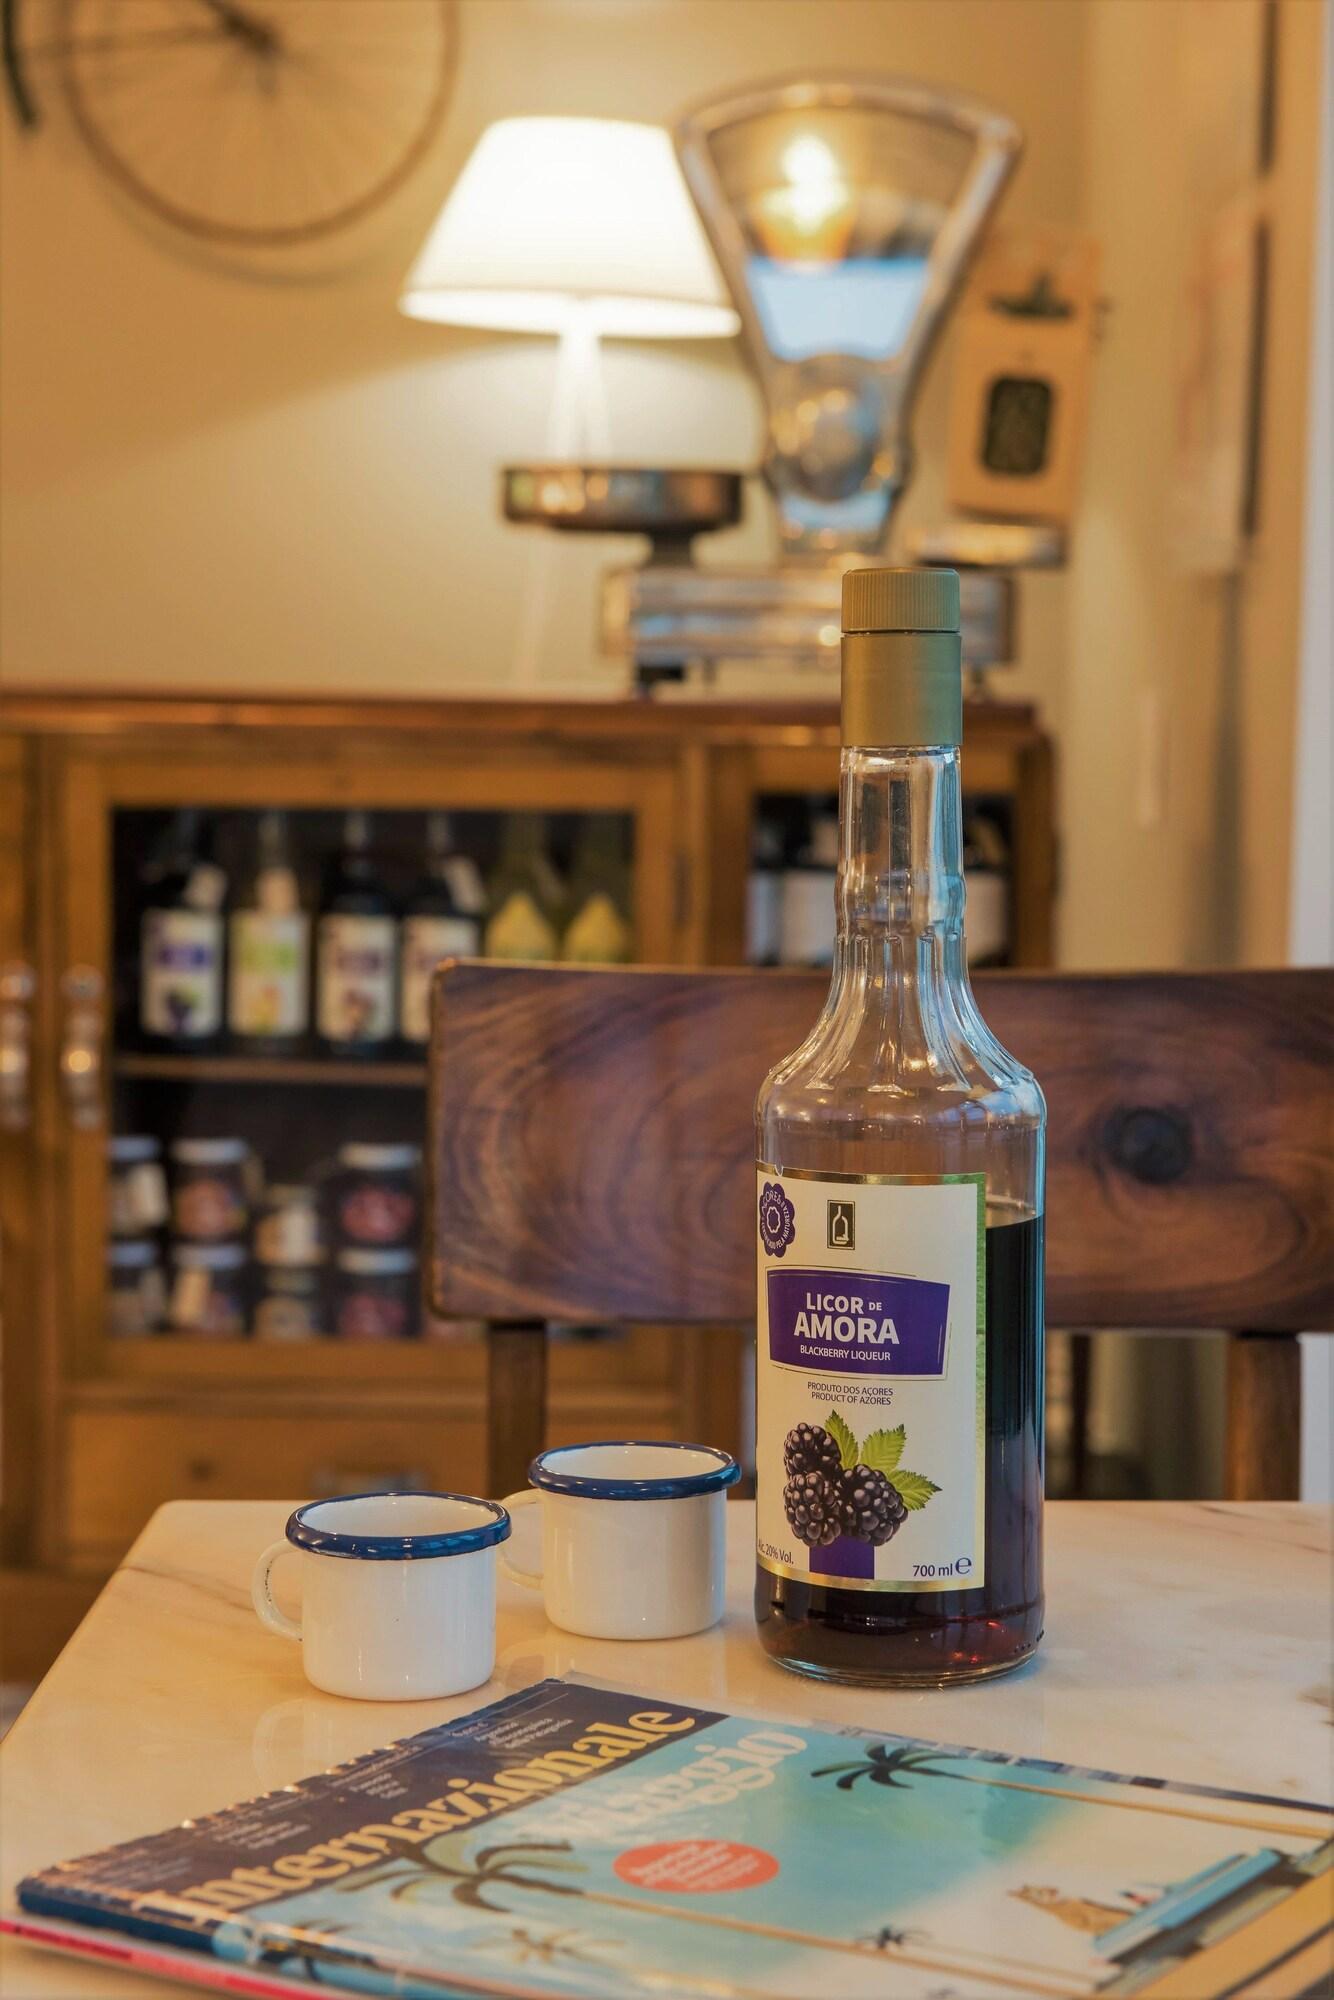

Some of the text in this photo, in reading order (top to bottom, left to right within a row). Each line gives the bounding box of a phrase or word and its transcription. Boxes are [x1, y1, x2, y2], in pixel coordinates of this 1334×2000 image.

[806, 1292, 883, 1315] LICOR DE
[793, 1311, 900, 1345] AMORA
[800, 1344, 891, 1361] BLACKBERRY LIQUEUR
[807, 1381, 894, 1397] PRODUTO DOS AÇORES
[811, 1391, 892, 1406] PRODUCT OF AZORES
[765, 1543, 779, 1560] 20%
[779, 1548, 794, 1565] Vol.
[912, 1564, 936, 1577] 700
[938, 1563, 953, 1577] ml
[131, 1710, 697, 1927] Internazionale
